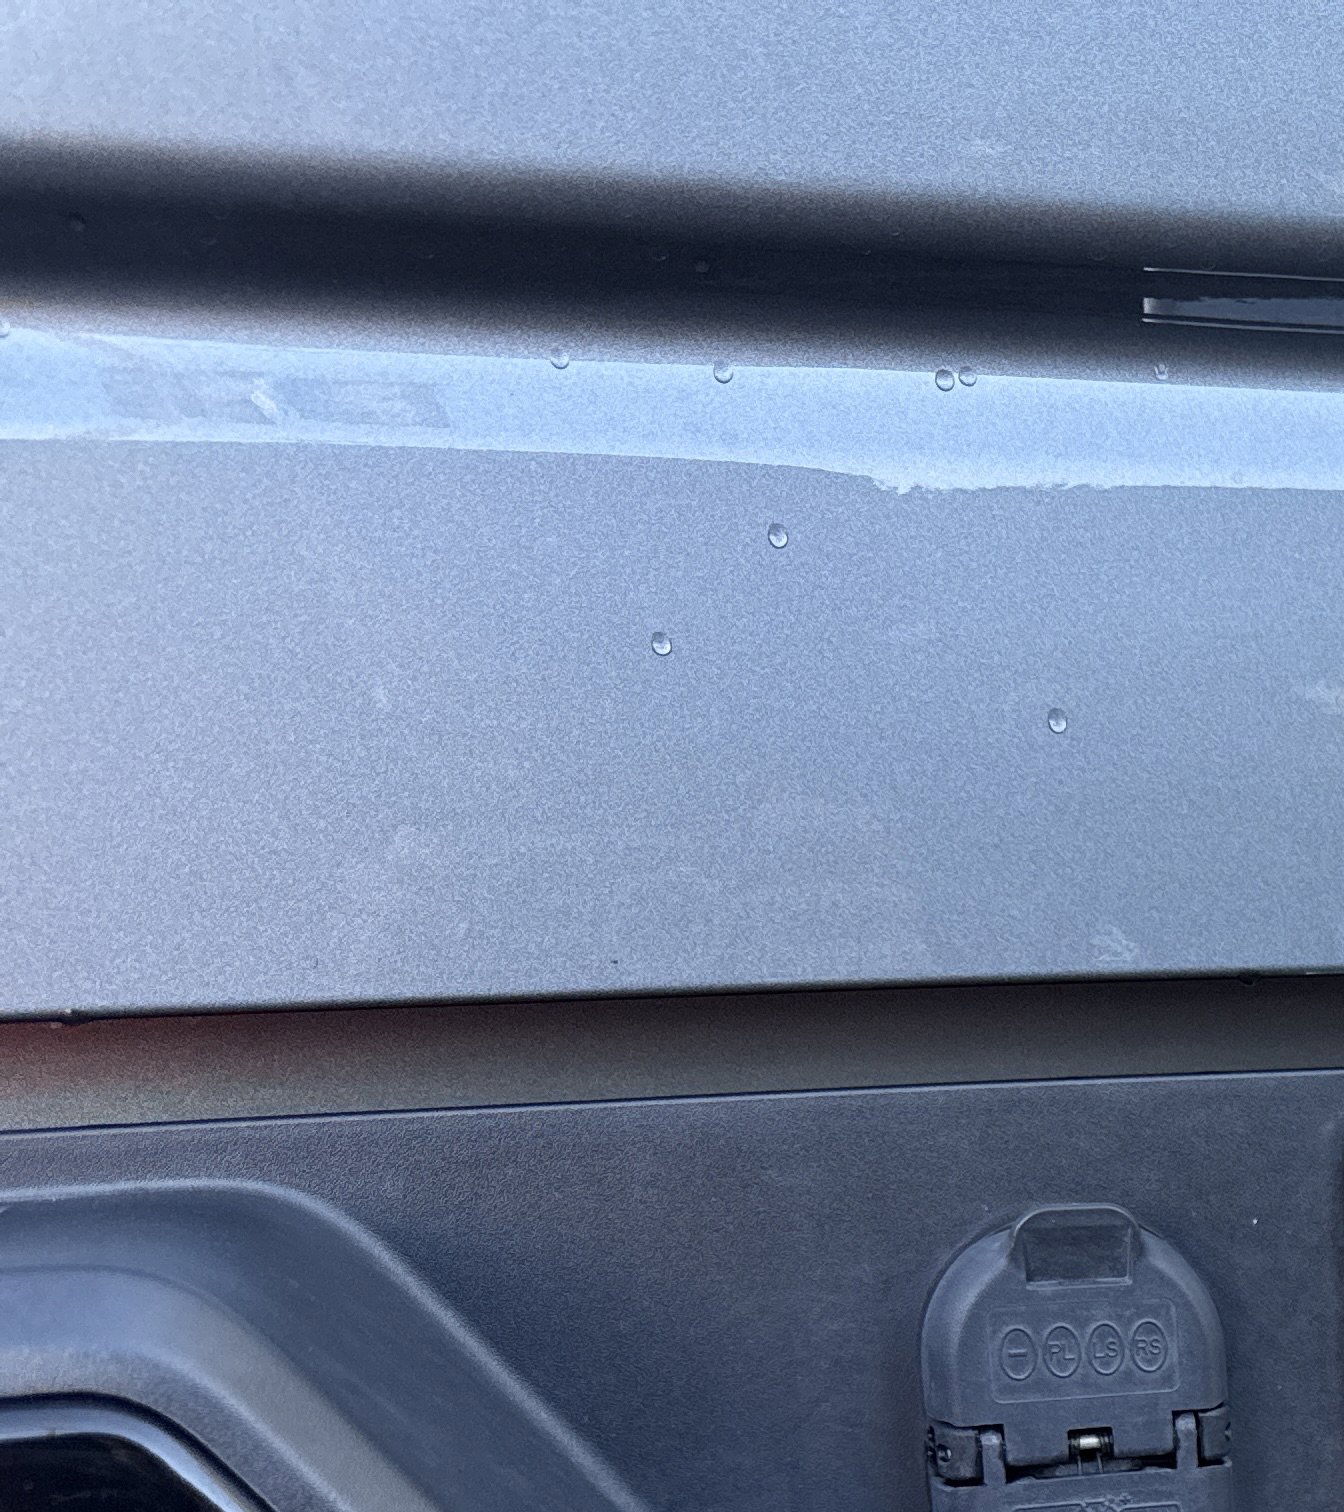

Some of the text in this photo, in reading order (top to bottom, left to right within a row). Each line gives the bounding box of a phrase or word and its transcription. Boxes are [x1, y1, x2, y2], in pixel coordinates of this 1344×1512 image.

[1048, 1338, 1161, 1361] PL LS RS
